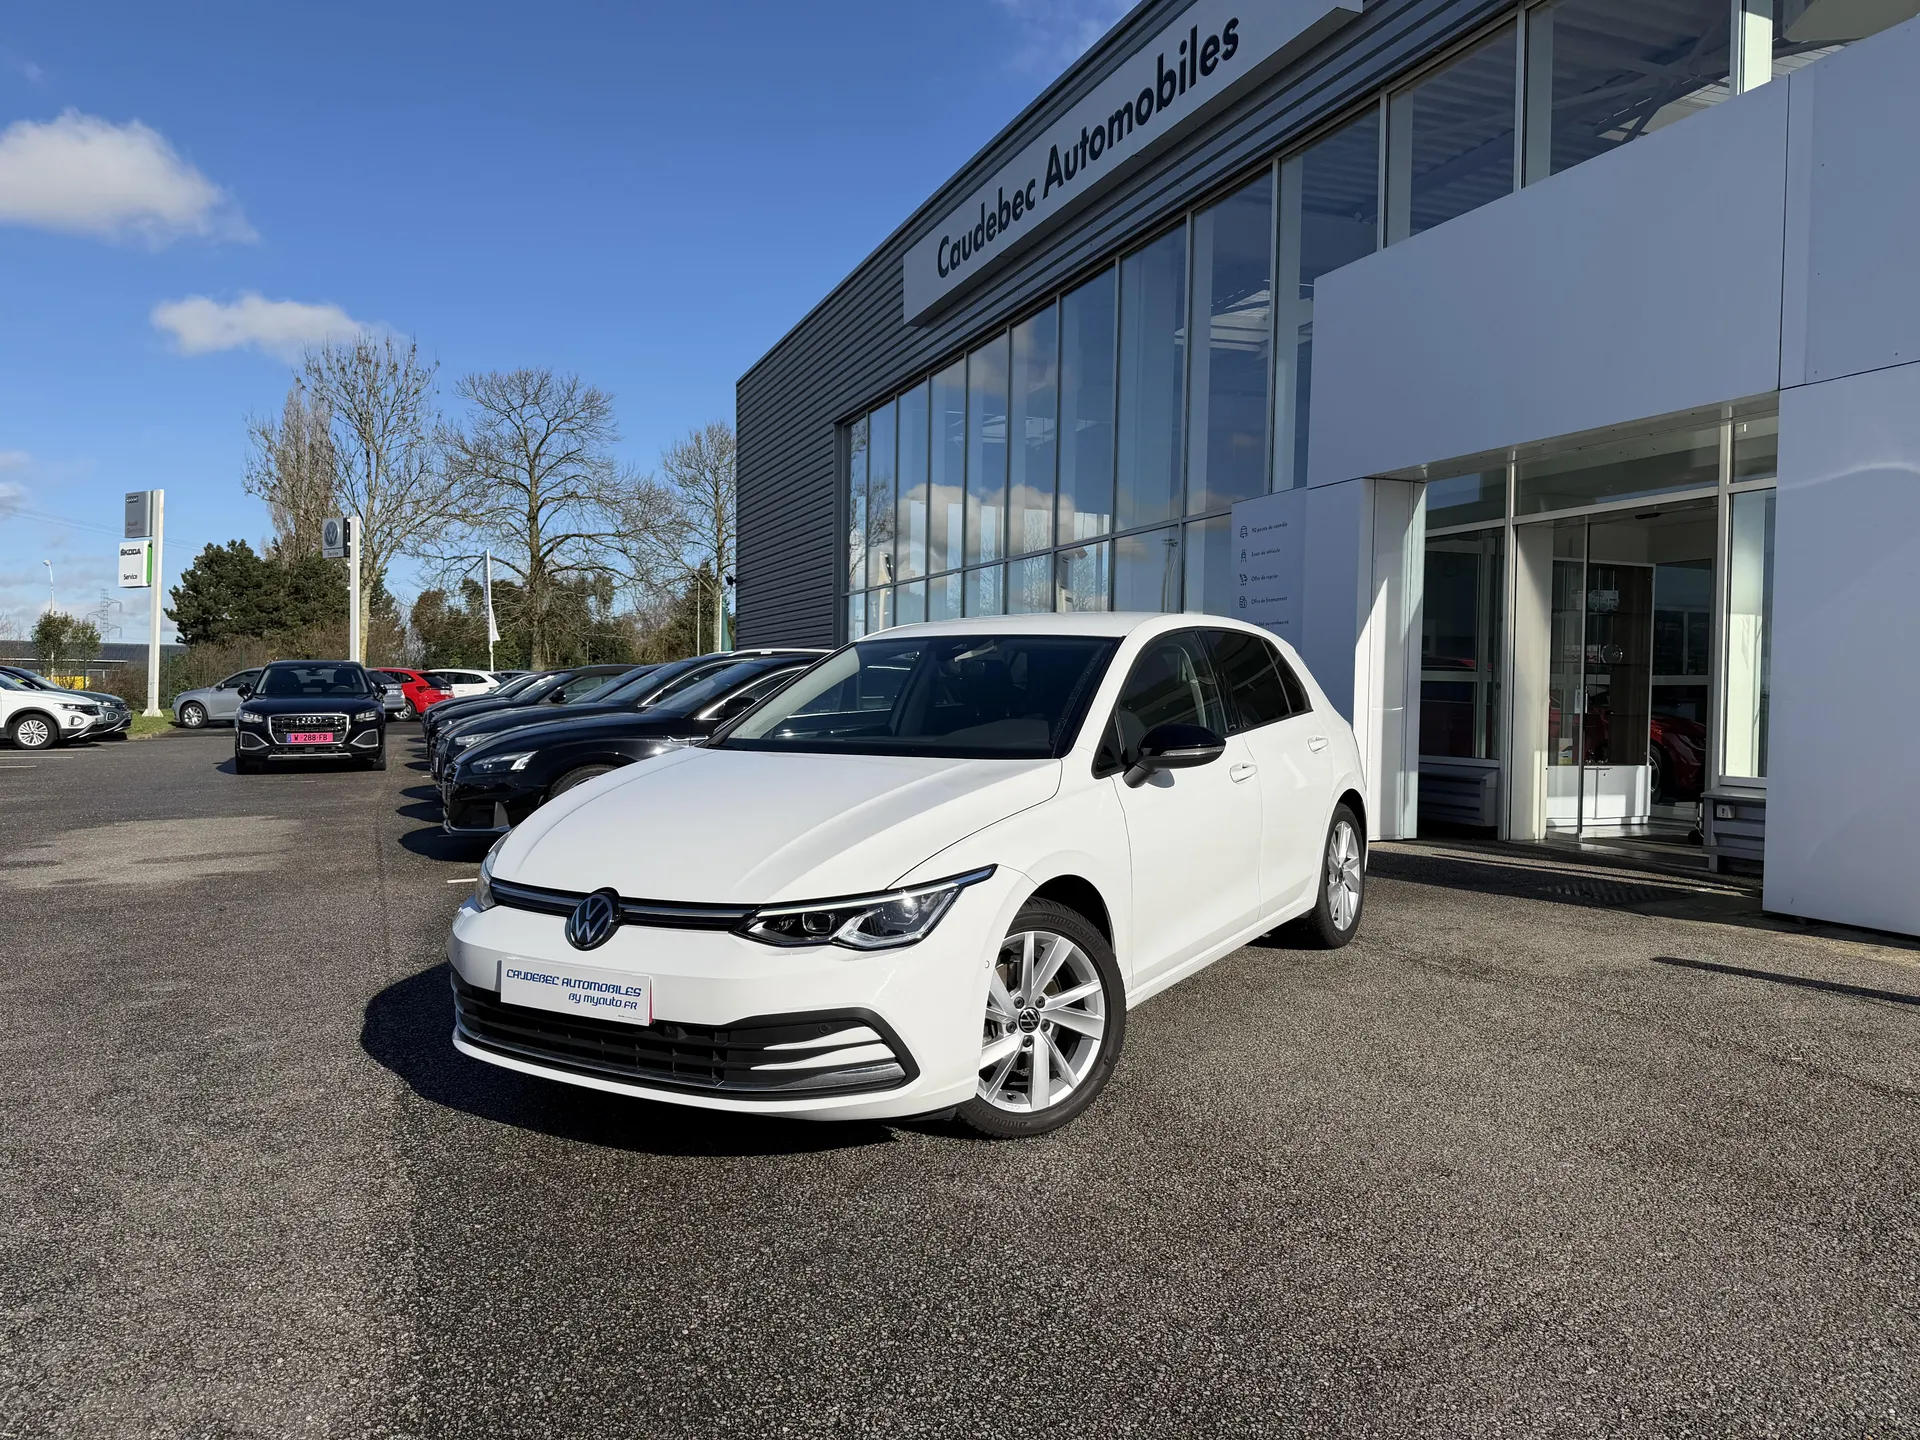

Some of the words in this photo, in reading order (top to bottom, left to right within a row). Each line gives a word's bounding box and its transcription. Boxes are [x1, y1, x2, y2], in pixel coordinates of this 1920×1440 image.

[936, 174, 1036, 280] Caudebec
[1042, 16, 1241, 200] Automobiles
[123, 573, 138, 581] Service
[506, 968, 560, 986] CAUDEBEC
[561, 977, 642, 998] AUTOMOBILES
